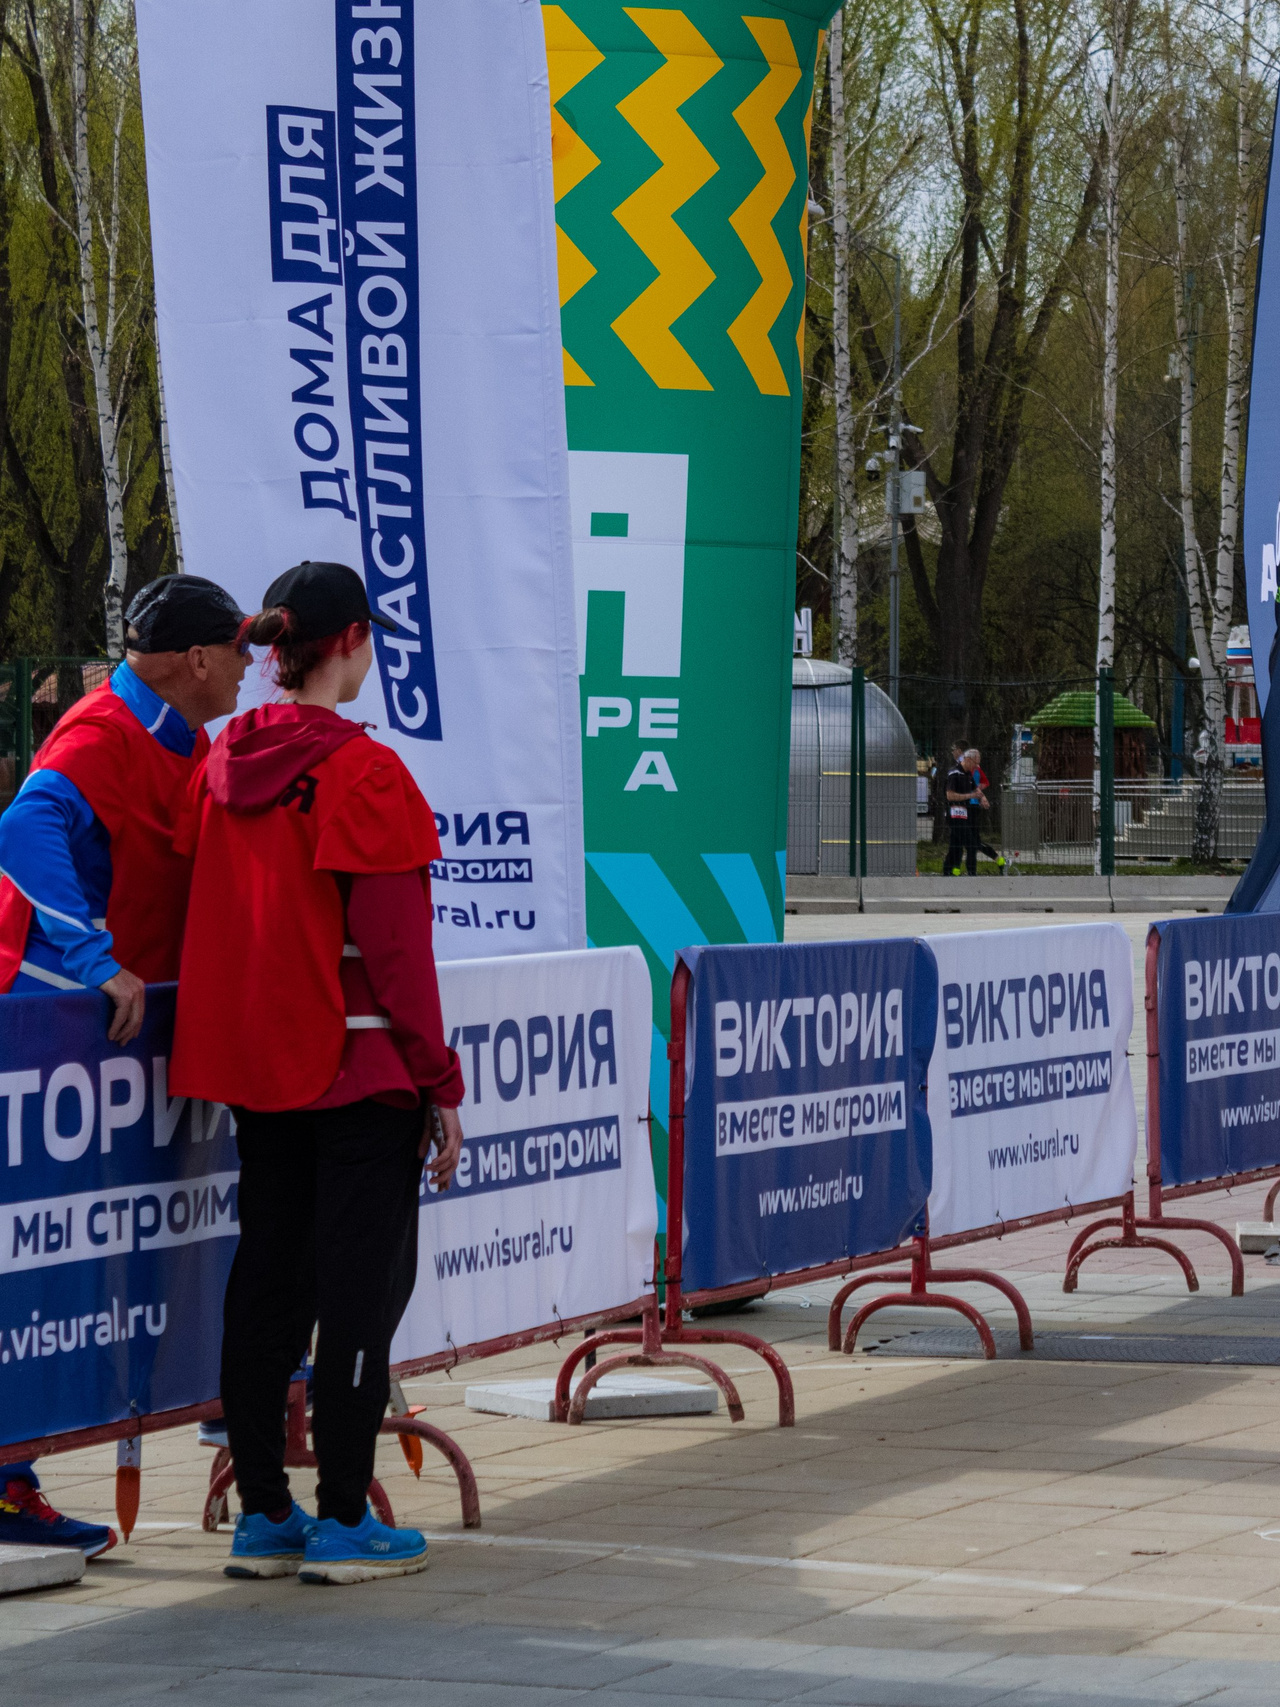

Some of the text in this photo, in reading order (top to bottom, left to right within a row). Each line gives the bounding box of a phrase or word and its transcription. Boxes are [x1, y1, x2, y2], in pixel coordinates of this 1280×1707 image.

[278, 113, 357, 521] ДОМА ДЛЯ
[344, 220, 428, 730] СЧАСТЛИВОЙ
[715, 988, 903, 1078] ВИКТОРИЯ
[943, 968, 1110, 1050] ВИКТОРИЯ
[449, 1009, 617, 1107] ТОРИЯ
[949, 1056, 1111, 1109] вместе мы строим
[1188, 1041, 1249, 1076] вместе
[1253, 1038, 1277, 1064] мы
[718, 1090, 902, 1146] вместе мы строим
[988, 1128, 1079, 1170] www.visural.ru
[478, 1140, 516, 1184] мы
[523, 1124, 619, 1179] строим
[11, 1183, 240, 1259] мы строим
[758, 1169, 863, 1218] www.visural.ru
[434, 1219, 573, 1281] www.visural.ru
